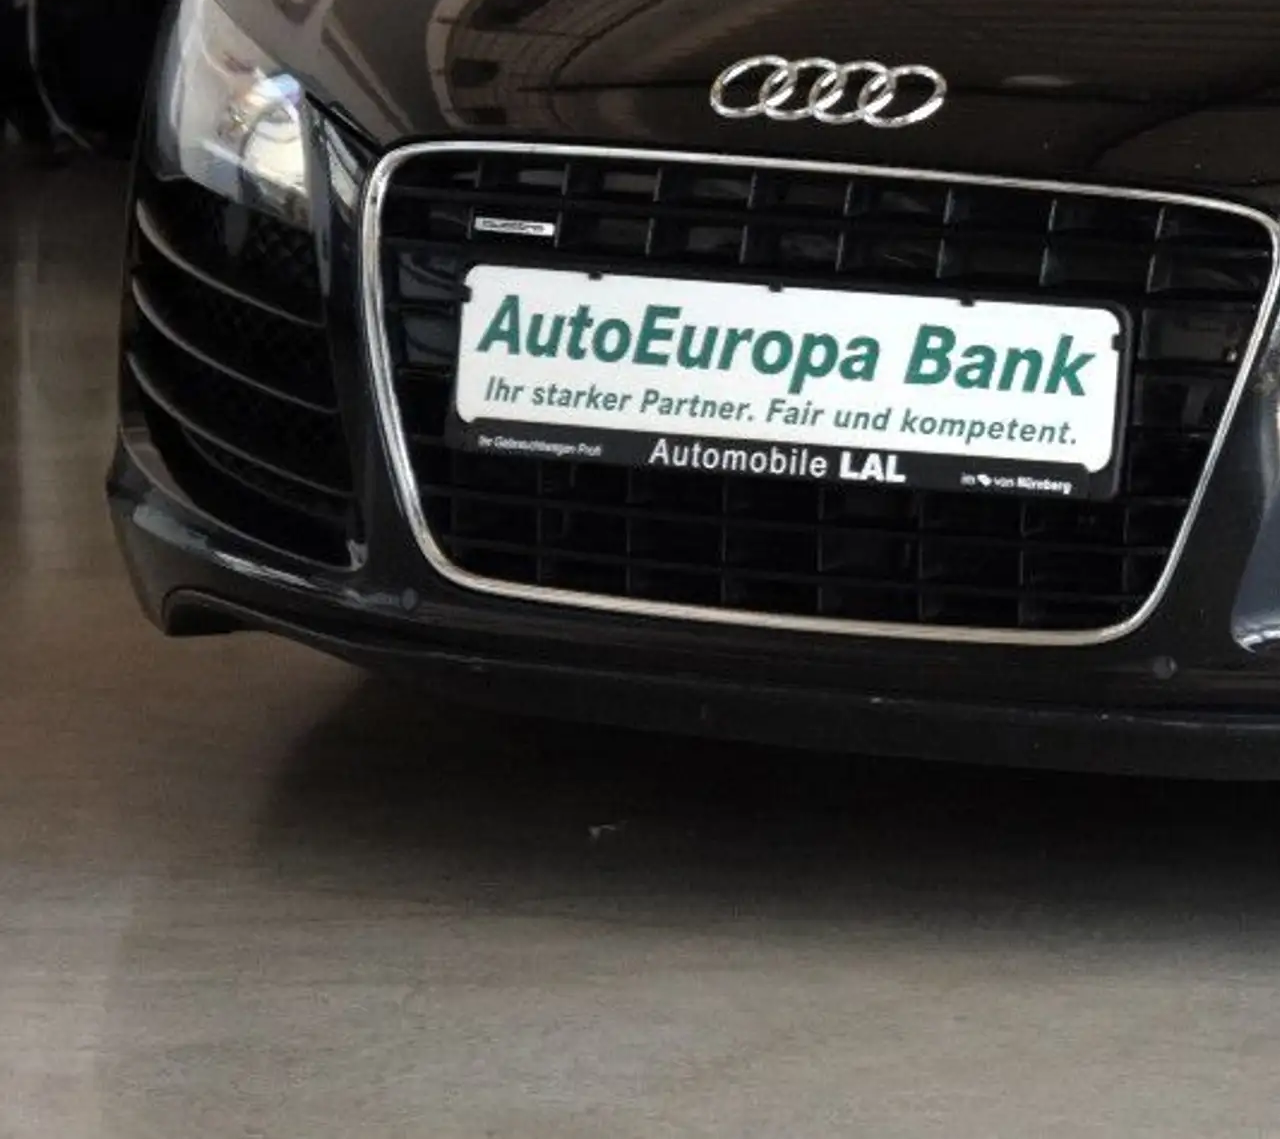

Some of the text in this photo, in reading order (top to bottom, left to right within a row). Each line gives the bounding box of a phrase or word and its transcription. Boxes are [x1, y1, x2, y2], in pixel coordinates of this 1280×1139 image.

[477, 294, 1096, 397] AutoEuropa Bank
[484, 375, 1078, 446] Ihr starker Partner. Fair und kompetent.
[649, 437, 907, 484] Automobile LAL
